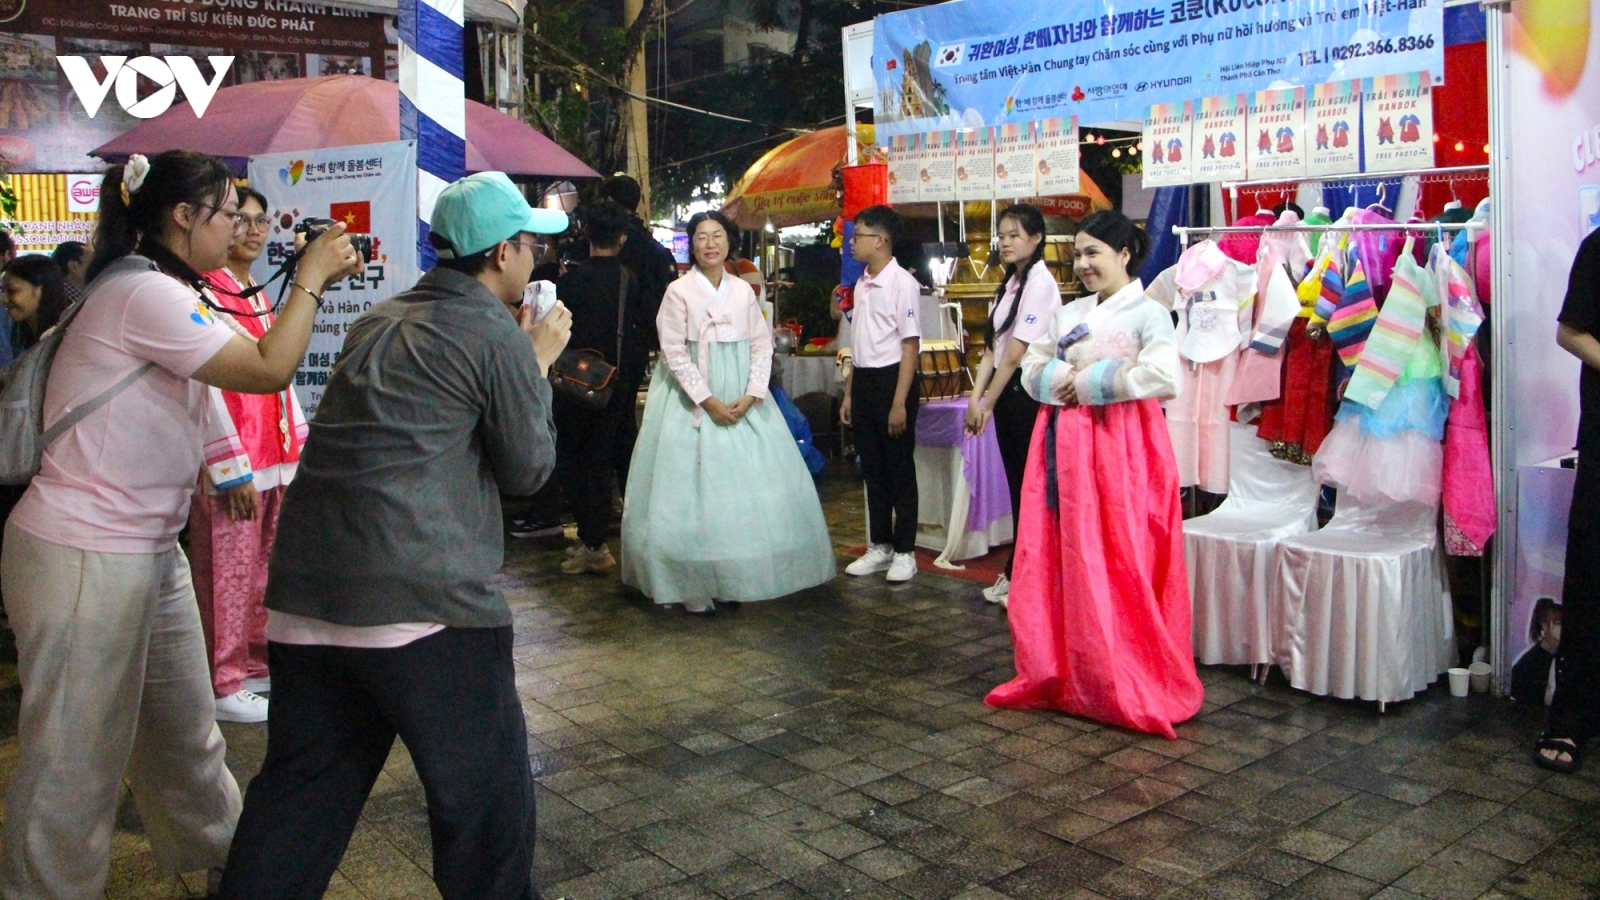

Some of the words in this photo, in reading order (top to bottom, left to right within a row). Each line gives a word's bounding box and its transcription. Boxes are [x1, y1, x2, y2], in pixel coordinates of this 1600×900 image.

[110, 4, 161, 20] TRANG
[164, 8, 186, 22] TRÍ
[190, 10, 208, 26] SỰ
[212, 12, 243, 28] KIỆN
[247, 14, 277, 28] ĐỨC
[281, 16, 316, 32] PHÁT
[1100, 7, 1165, 36] 함께하는
[96, 22, 118, 32] Công
[121, 24, 138, 32] Viên
[980, 68, 998, 80] tâm
[998, 61, 1041, 80] Việt-Hàn
[1044, 59, 1074, 70] Chung
[1076, 54, 1090, 66] tay
[1092, 48, 1120, 62] Chăm
[1122, 43, 1141, 57] sóc
[1144, 40, 1170, 54] cùng
[1172, 34, 1188, 48] với
[1192, 32, 1214, 46] Phụ
[1217, 27, 1233, 41] nữ
[1236, 23, 1253, 38] hồi
[1256, 20, 1296, 34] hương
[1298, 12, 1312, 26] và
[1341, 7, 1360, 20] em
[1298, 50, 1322, 67] TEL
[1332, 34, 1434, 61] 0292.366.8366
[1232, 63, 1244, 71] Liên
[1245, 60, 1260, 70] Hiệp
[1262, 58, 1275, 68] Phụ
[1150, 76, 1192, 90] HYUNDAI
[1378, 100, 1416, 112] HANBOK
[1258, 114, 1291, 124] HANBOK
[1317, 108, 1348, 118] HANBOK
[1204, 120, 1234, 129] HANBOK
[1042, 130, 1060, 139] TRANG
[1152, 126, 1181, 136] HANBOK
[328, 160, 346, 174] 함께
[752, 196, 770, 216] Gia
[774, 194, 784, 208] vị
[786, 192, 811, 206] cuộc
[1058, 199, 1084, 210] FOOD
[22, 221, 56, 230] OANH
[58, 218, 90, 230] NHÂN
[322, 300, 334, 314] và
[338, 300, 360, 314] Hàn
